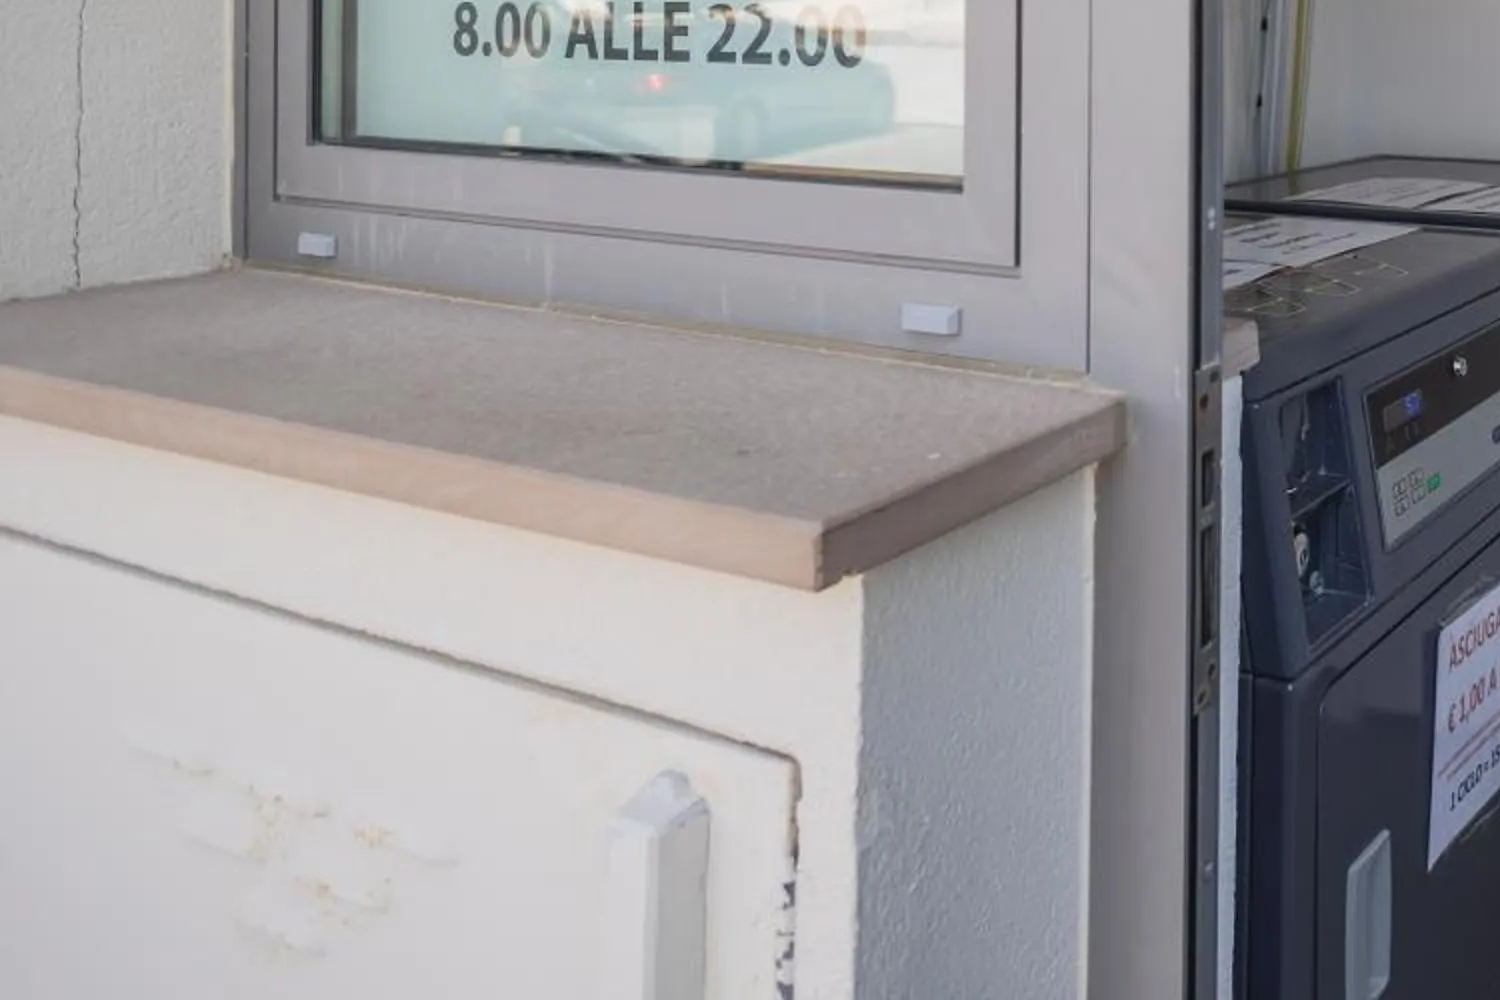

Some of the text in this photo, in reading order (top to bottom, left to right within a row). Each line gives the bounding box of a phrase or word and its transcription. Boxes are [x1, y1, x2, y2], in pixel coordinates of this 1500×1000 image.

[453, 1, 868, 69] 8.00 ALLE 22.00
[1457, 763, 1483, 803] CICLO
